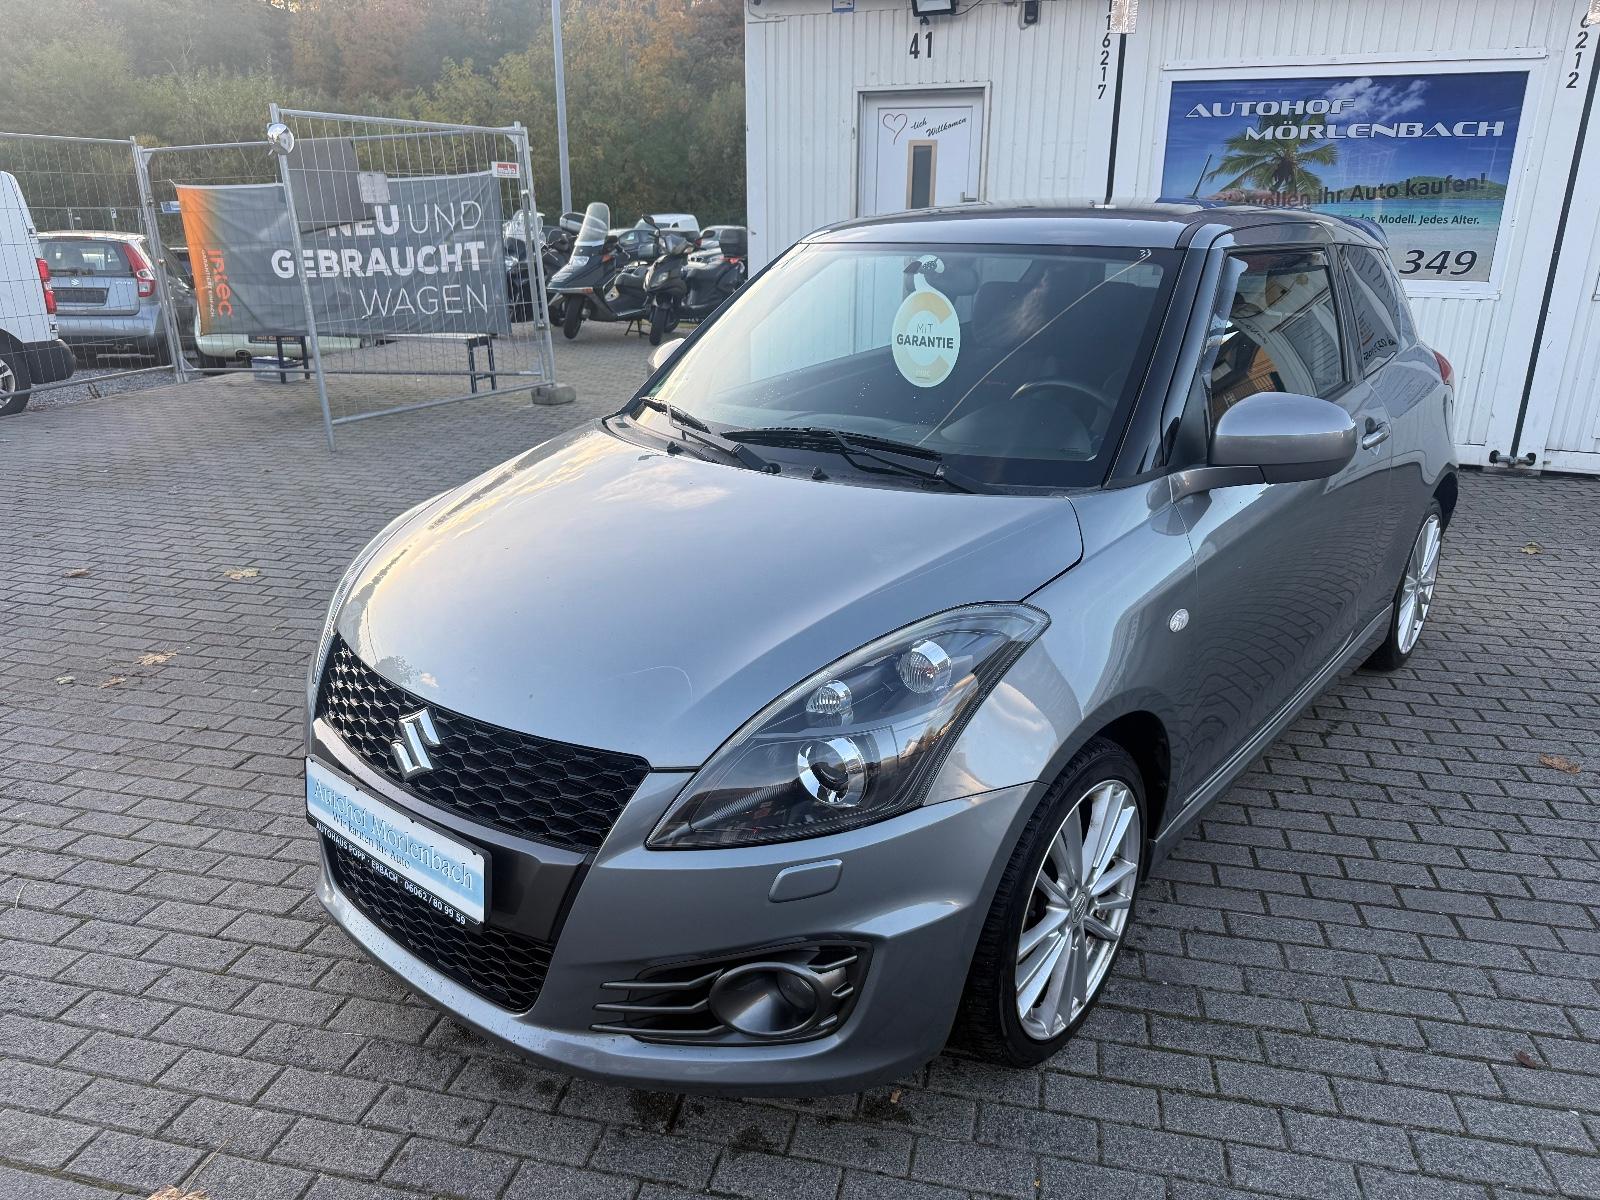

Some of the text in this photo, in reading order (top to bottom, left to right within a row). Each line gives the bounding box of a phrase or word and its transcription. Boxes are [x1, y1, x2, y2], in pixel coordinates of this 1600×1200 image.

[908, 31, 934, 60] 41
[1184, 98, 1356, 119] AUTOHOF
[1245, 120, 1505, 142] MÖRLENBACH
[1350, 184, 1399, 201] Auto
[1405, 172, 1487, 196] kaufen!
[407, 200, 482, 234] UND
[1378, 214, 1417, 225] Modell.
[1418, 214, 1449, 226] Jedes
[1451, 215, 1480, 225] Alter.
[270, 240, 486, 279] GEBRAUCHT
[1398, 249, 1478, 276] 349
[359, 284, 489, 320] WAGEN
[896, 333, 954, 350] GARANTIE
[313, 779, 367, 830] Autohof
[316, 820, 349, 850] AUTOHAUS
[371, 860, 399, 884] ERBACH
